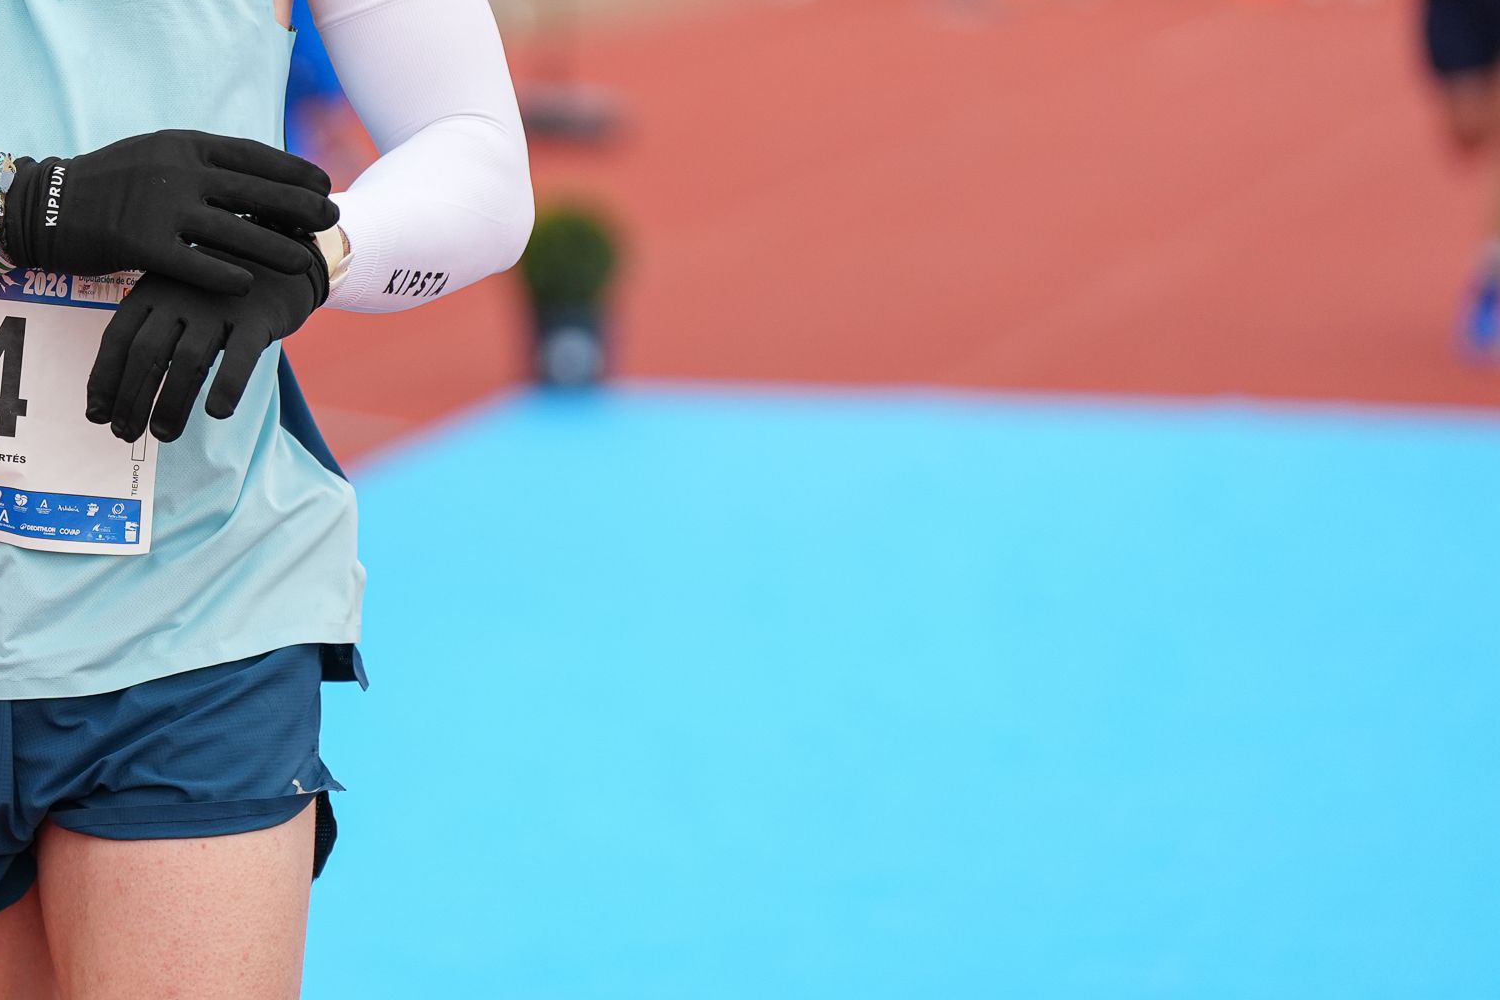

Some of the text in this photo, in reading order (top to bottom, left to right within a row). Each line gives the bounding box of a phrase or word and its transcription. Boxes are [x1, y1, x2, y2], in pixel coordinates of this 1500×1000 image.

[45, 166, 66, 227] KIPRUN
[23, 270, 68, 297] 2026
[382, 269, 450, 297] KIPSTA
[131, 464, 140, 496] TIEMPO
[59, 527, 81, 536] COVAP
